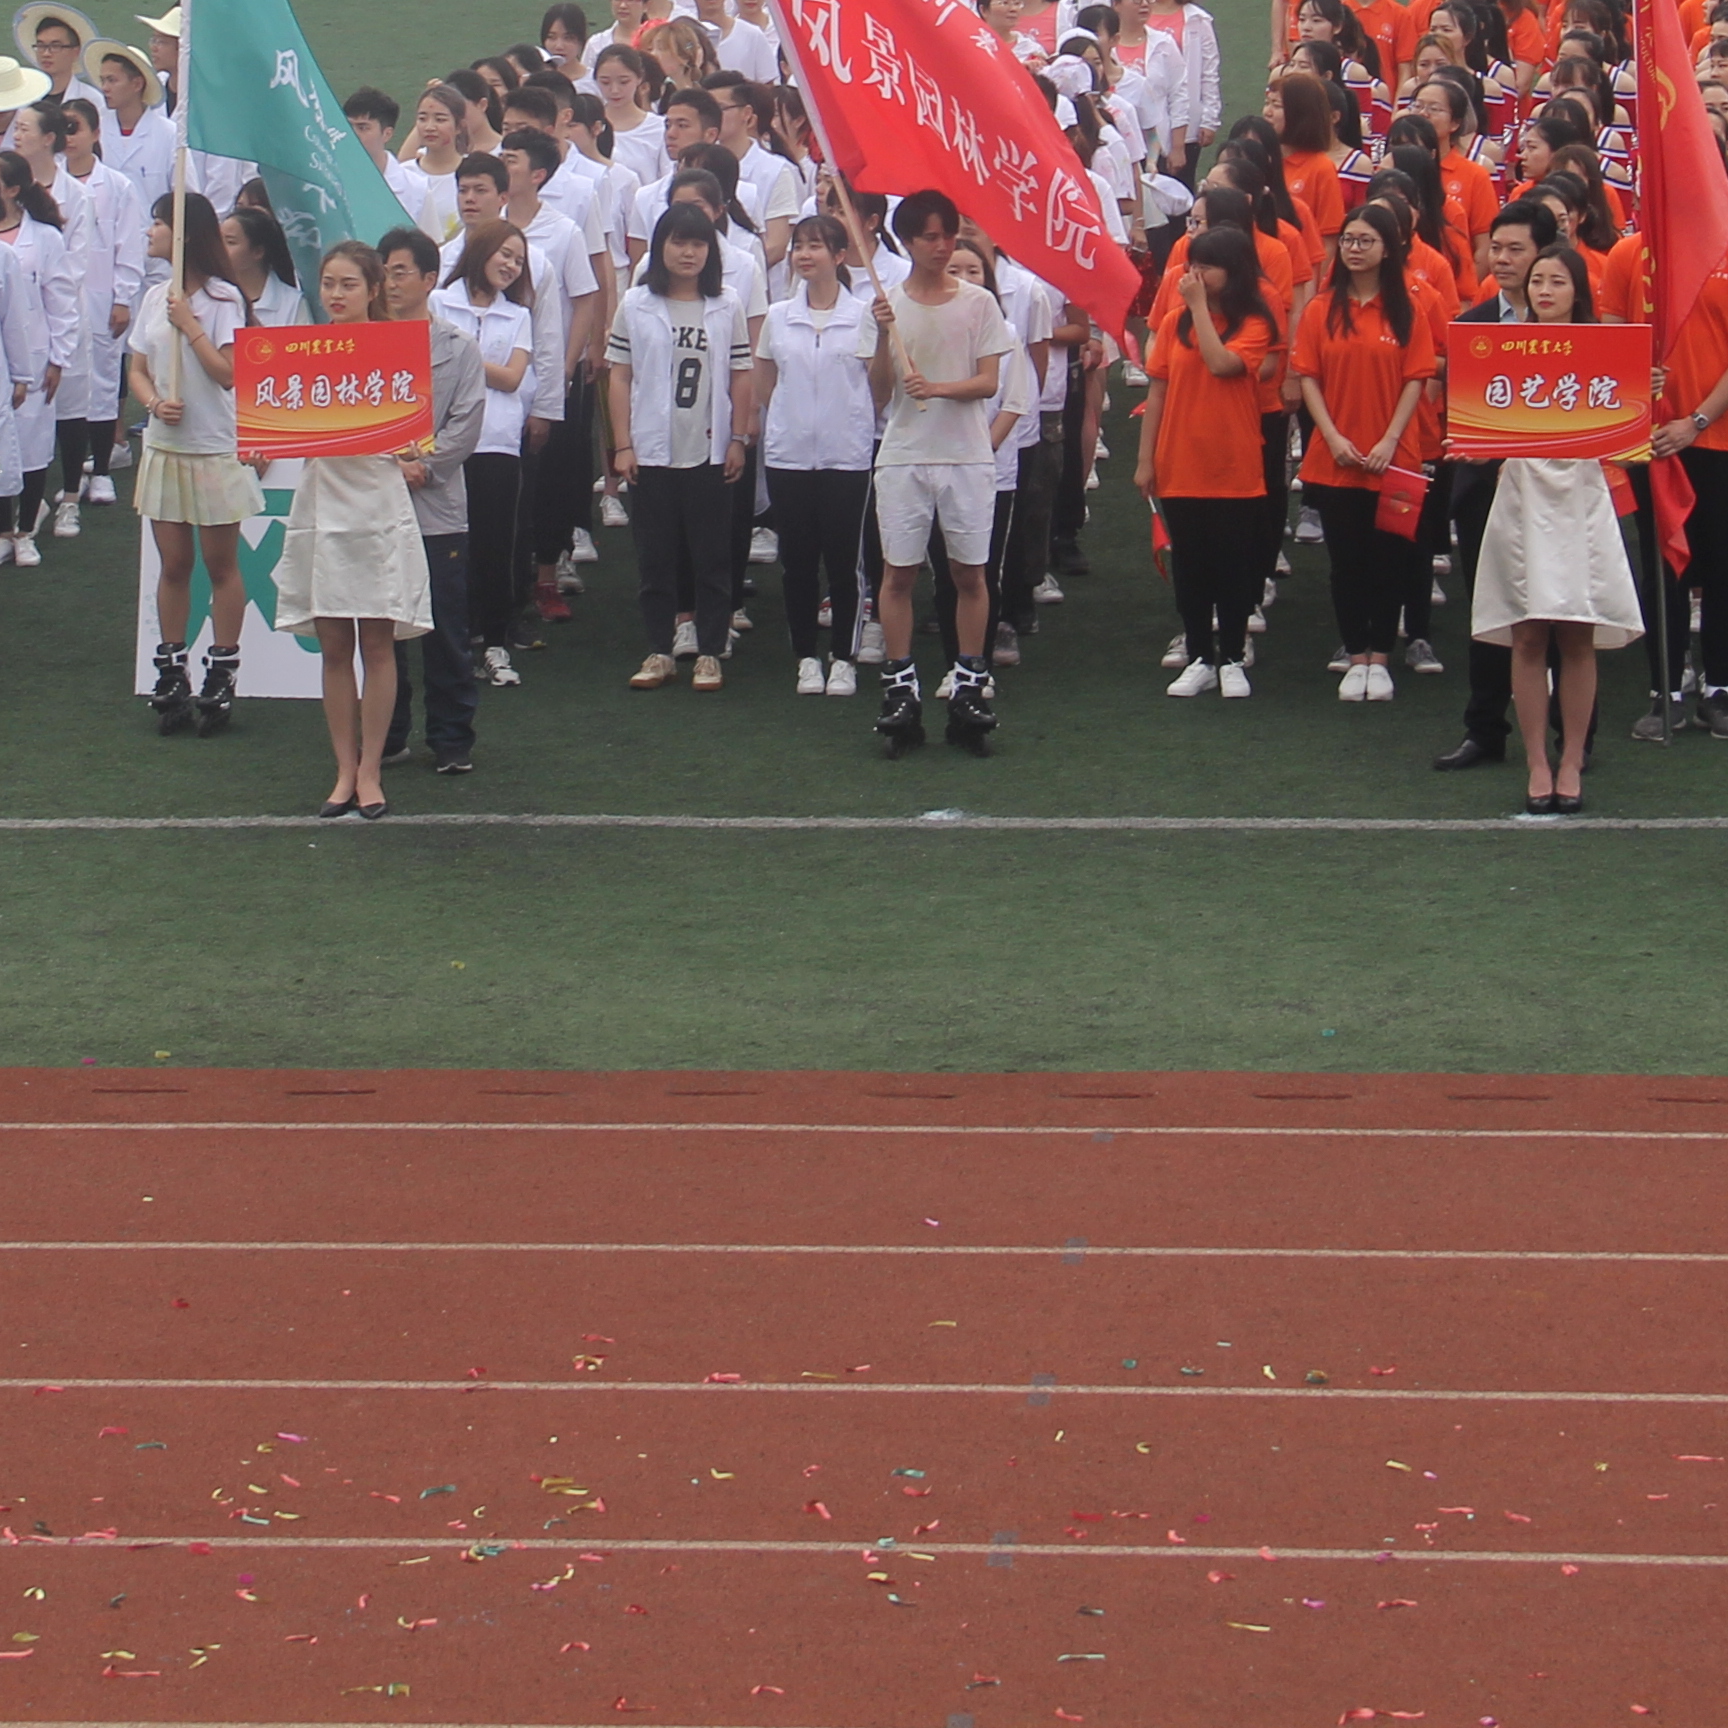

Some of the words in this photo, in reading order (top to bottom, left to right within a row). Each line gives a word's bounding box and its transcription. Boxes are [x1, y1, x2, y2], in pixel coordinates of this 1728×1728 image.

[255, 369, 417, 410] 风景园林学院
[1484, 372, 1621, 411] 园艺学院
